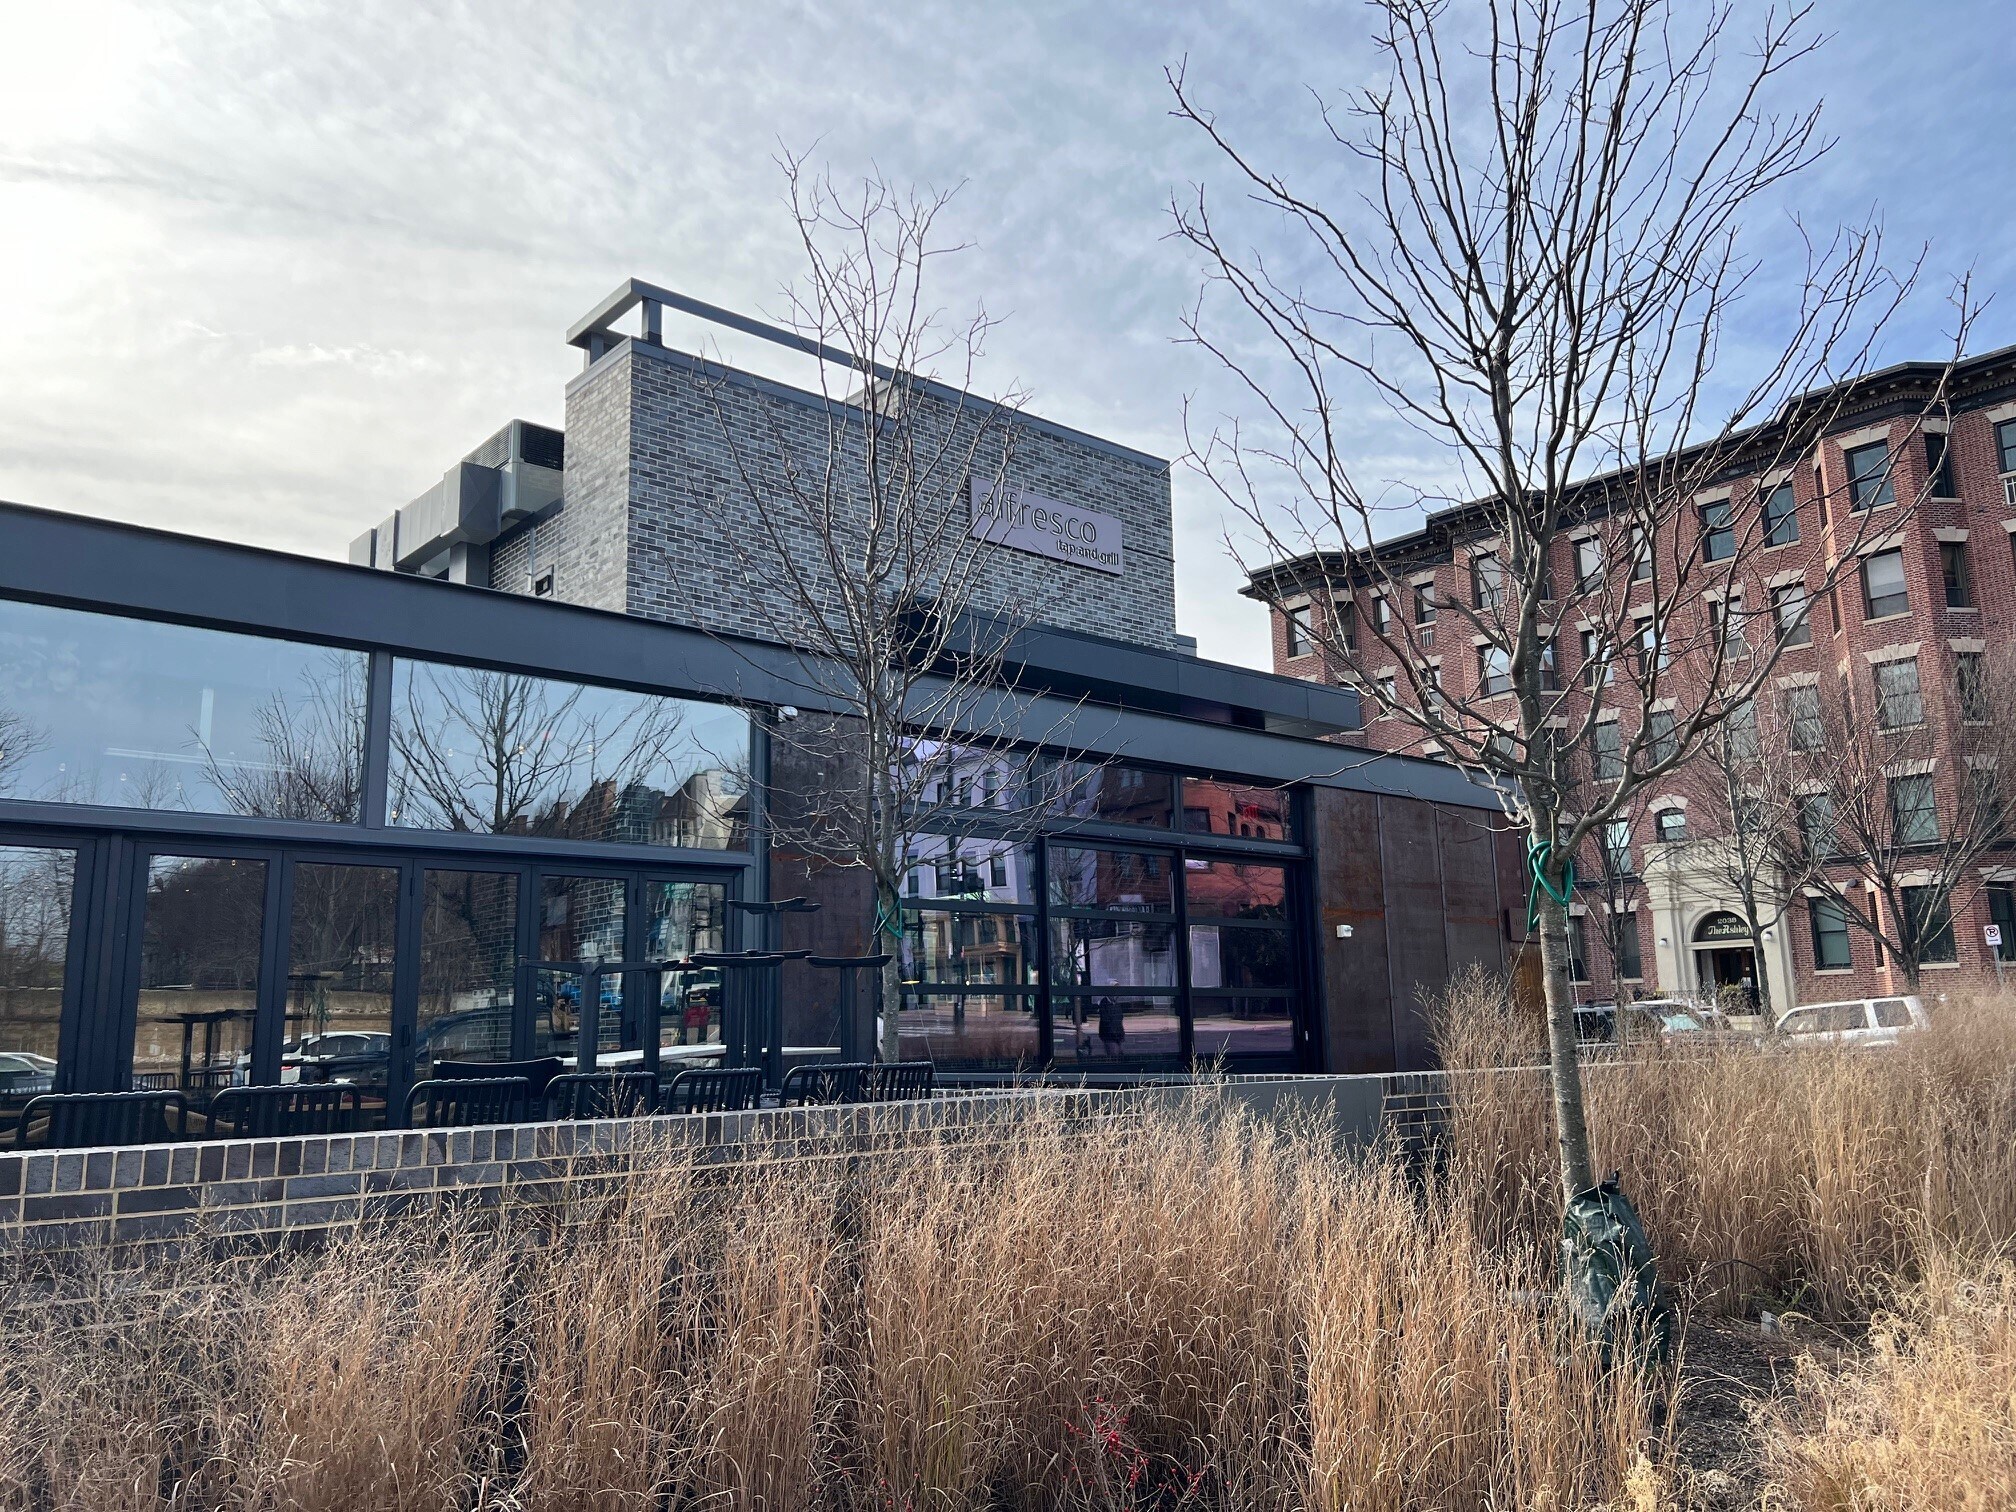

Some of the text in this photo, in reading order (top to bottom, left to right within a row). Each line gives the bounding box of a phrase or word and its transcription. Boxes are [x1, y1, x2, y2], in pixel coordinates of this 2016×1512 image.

[978, 491, 1097, 544] alfresco
[1056, 538, 1120, 566] tap and grill
[1707, 924, 1749, 936] The Ashley
